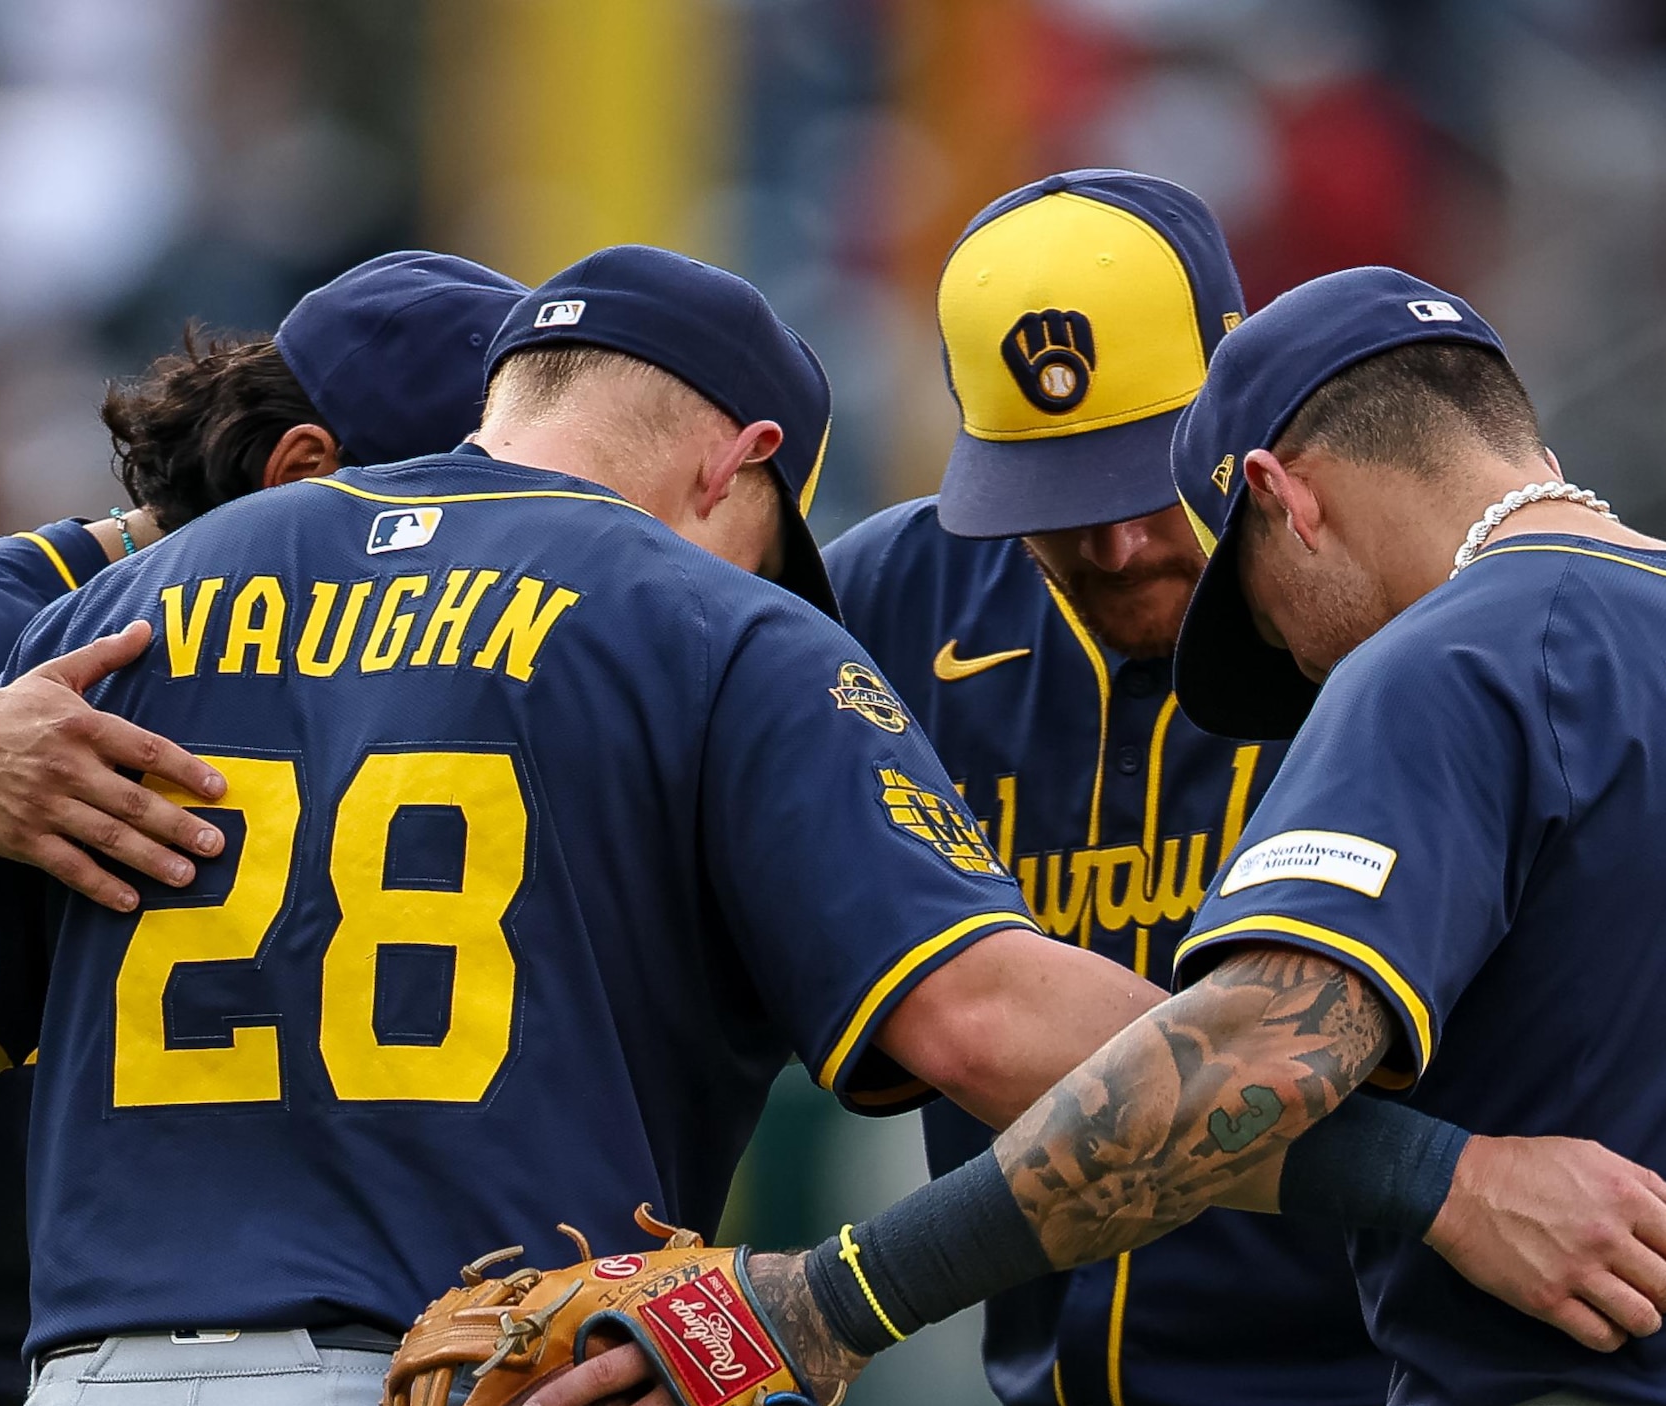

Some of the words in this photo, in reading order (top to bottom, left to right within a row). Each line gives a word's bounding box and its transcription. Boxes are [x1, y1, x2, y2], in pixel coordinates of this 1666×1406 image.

[160, 568, 580, 684] VAUGHN
[1262, 855, 1321, 871] Mutual
[1267, 843, 1382, 871] Northwestern
[113, 750, 530, 1106] 28
[668, 1298, 747, 1381] Rawlings
